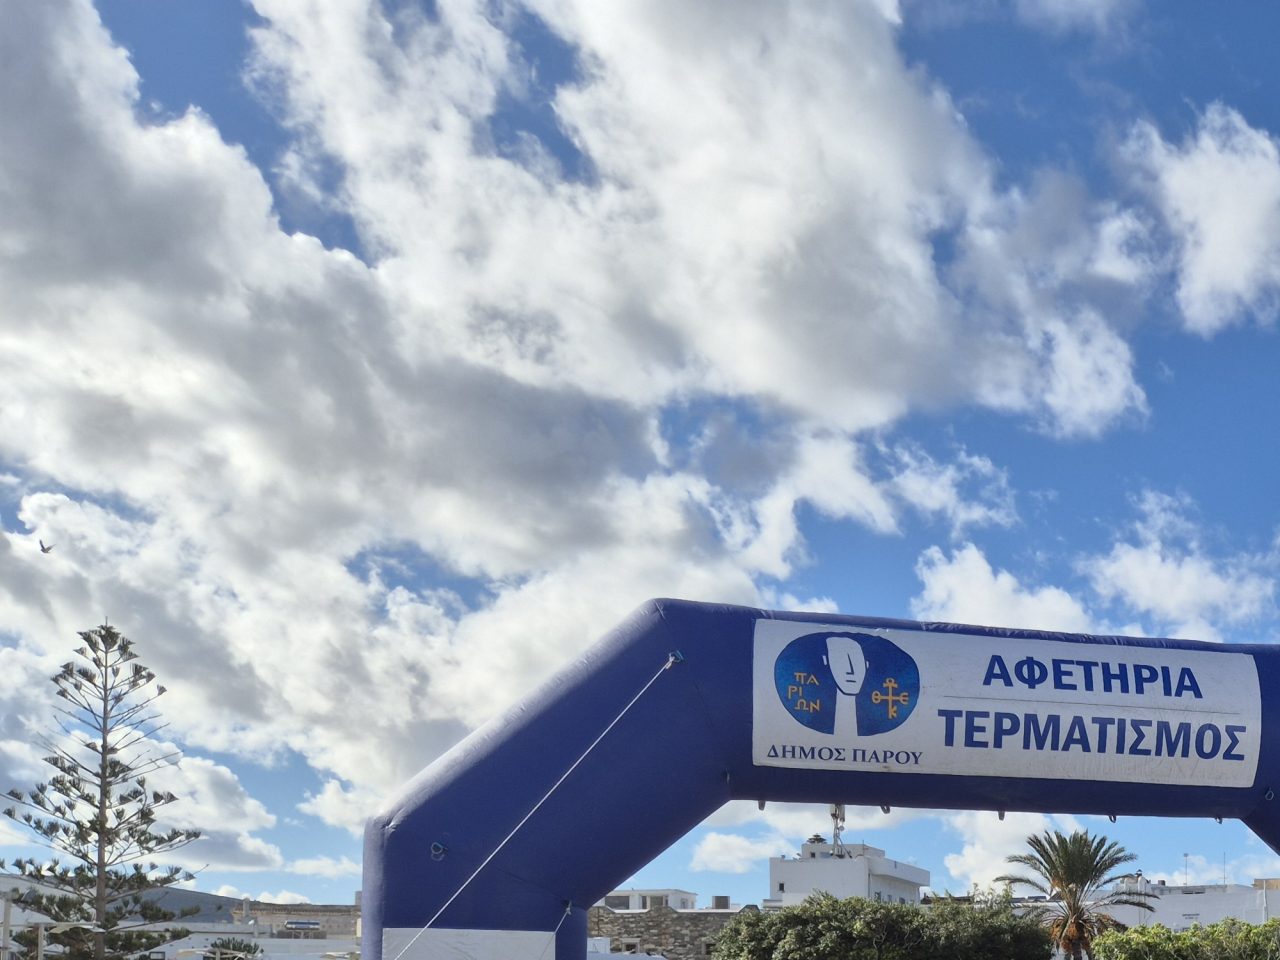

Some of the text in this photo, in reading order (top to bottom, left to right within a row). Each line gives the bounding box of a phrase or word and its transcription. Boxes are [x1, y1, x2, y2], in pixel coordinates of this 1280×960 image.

[982, 654, 1203, 699] ΑΦΕΤΗΡΙΑ
[766, 744, 924, 765] ΔΗΜΟΣ ΠΑΡΟΥ
[937, 708, 1247, 761] ΤΕΡΜΑΤΙΣΜΟΣ
